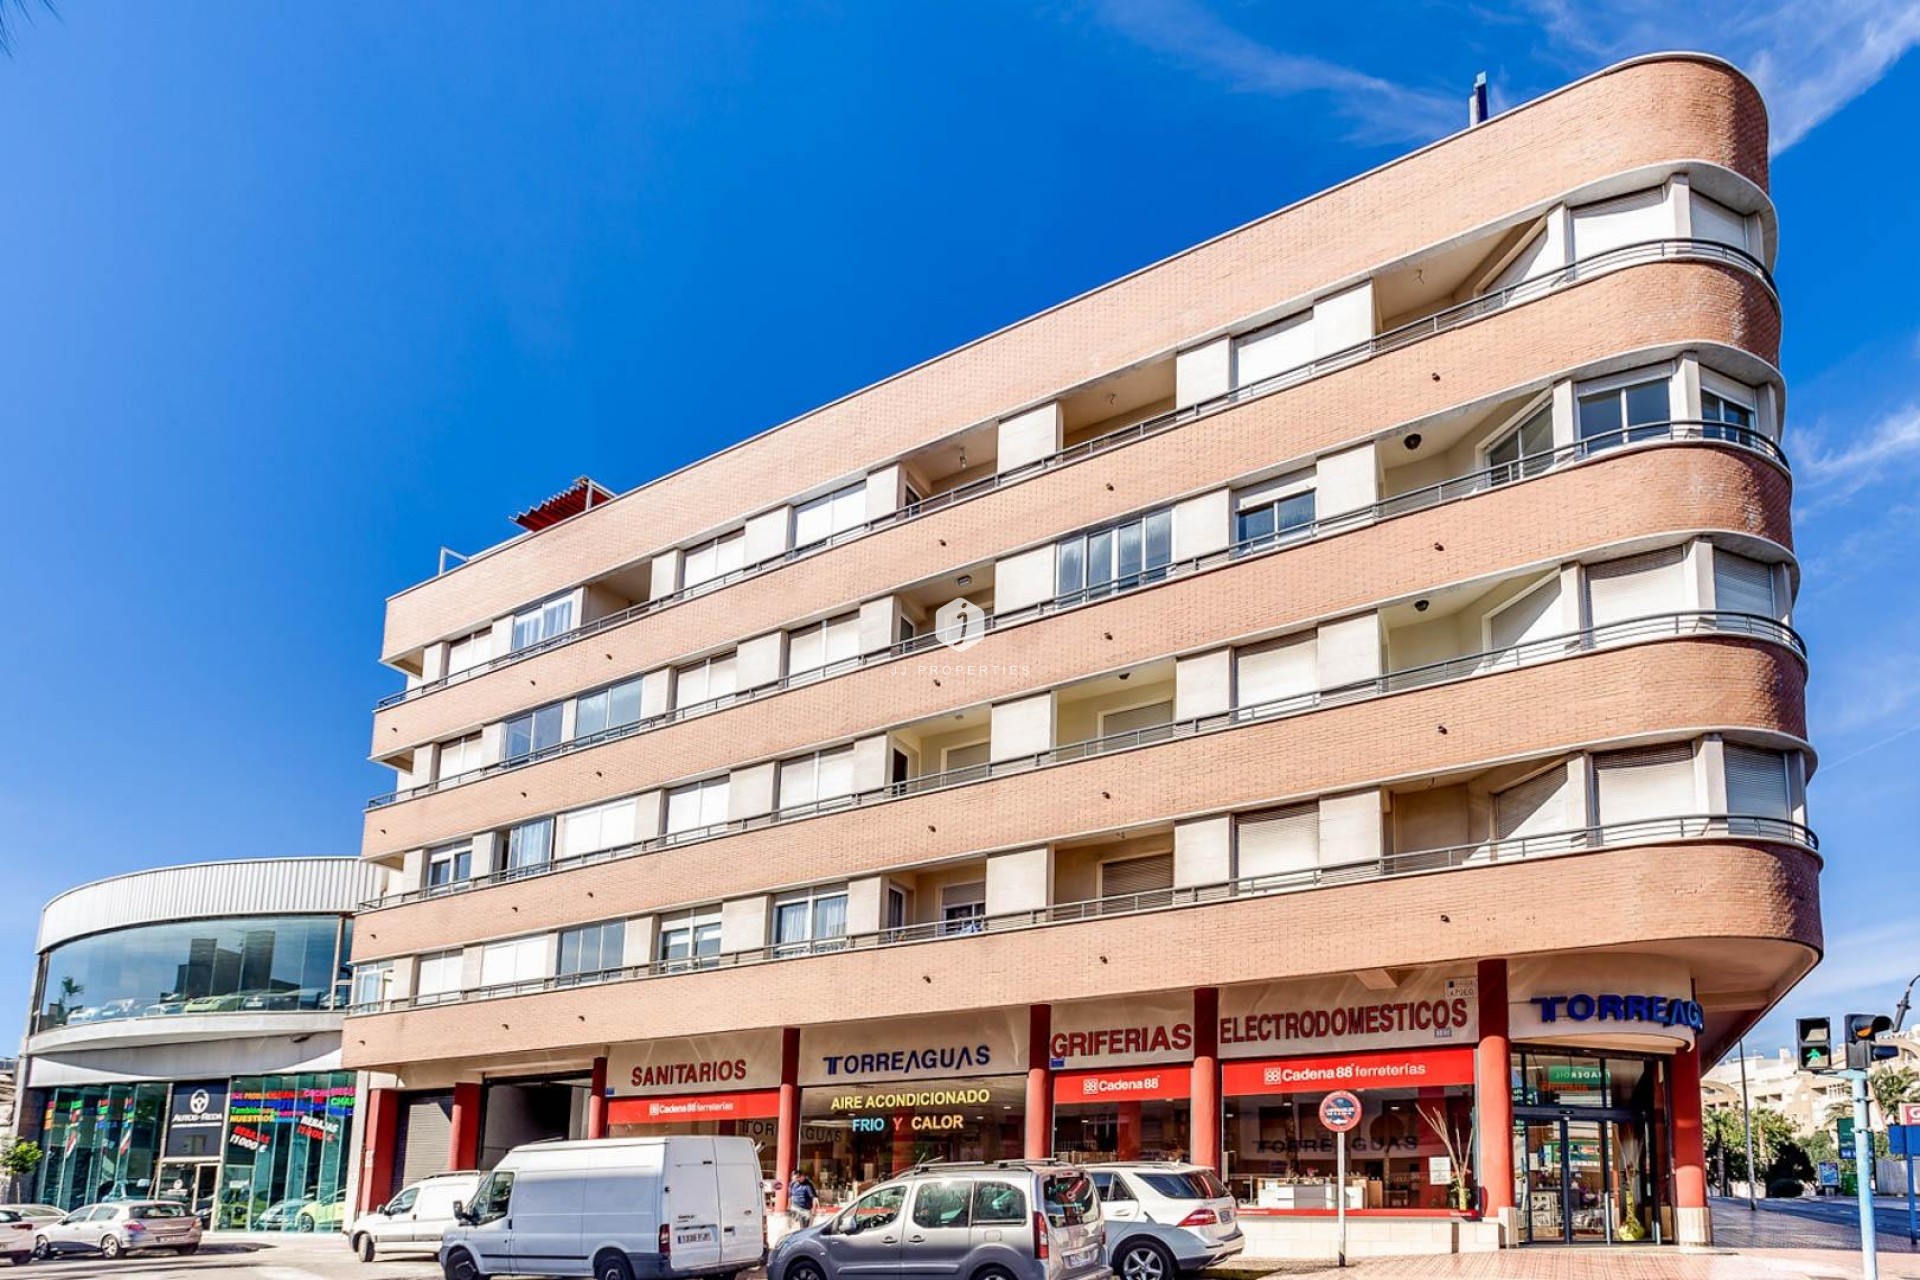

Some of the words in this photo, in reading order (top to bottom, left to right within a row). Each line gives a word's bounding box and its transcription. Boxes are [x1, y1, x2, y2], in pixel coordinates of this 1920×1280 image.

[1220, 998, 1468, 1043] ELECTRODOMESTICOS
[1051, 1023, 1192, 1058] GRIFERIAS
[823, 1045, 991, 1075] TORREAGUAS
[1282, 1068, 1335, 1081] Cadena
[1336, 1066, 1352, 1077] 88
[1355, 1063, 1427, 1077] ferreterías
[631, 1059, 747, 1087] SANITARIOS
[1099, 1079, 1143, 1091] Cadena
[1144, 1078, 1159, 1088] 88
[831, 1096, 863, 1110] AIRE
[865, 1089, 990, 1108] ACONDICIONADO
[852, 1118, 885, 1132] FRIO
[893, 1117, 903, 1131] Y
[911, 1115, 964, 1130] CALOR
